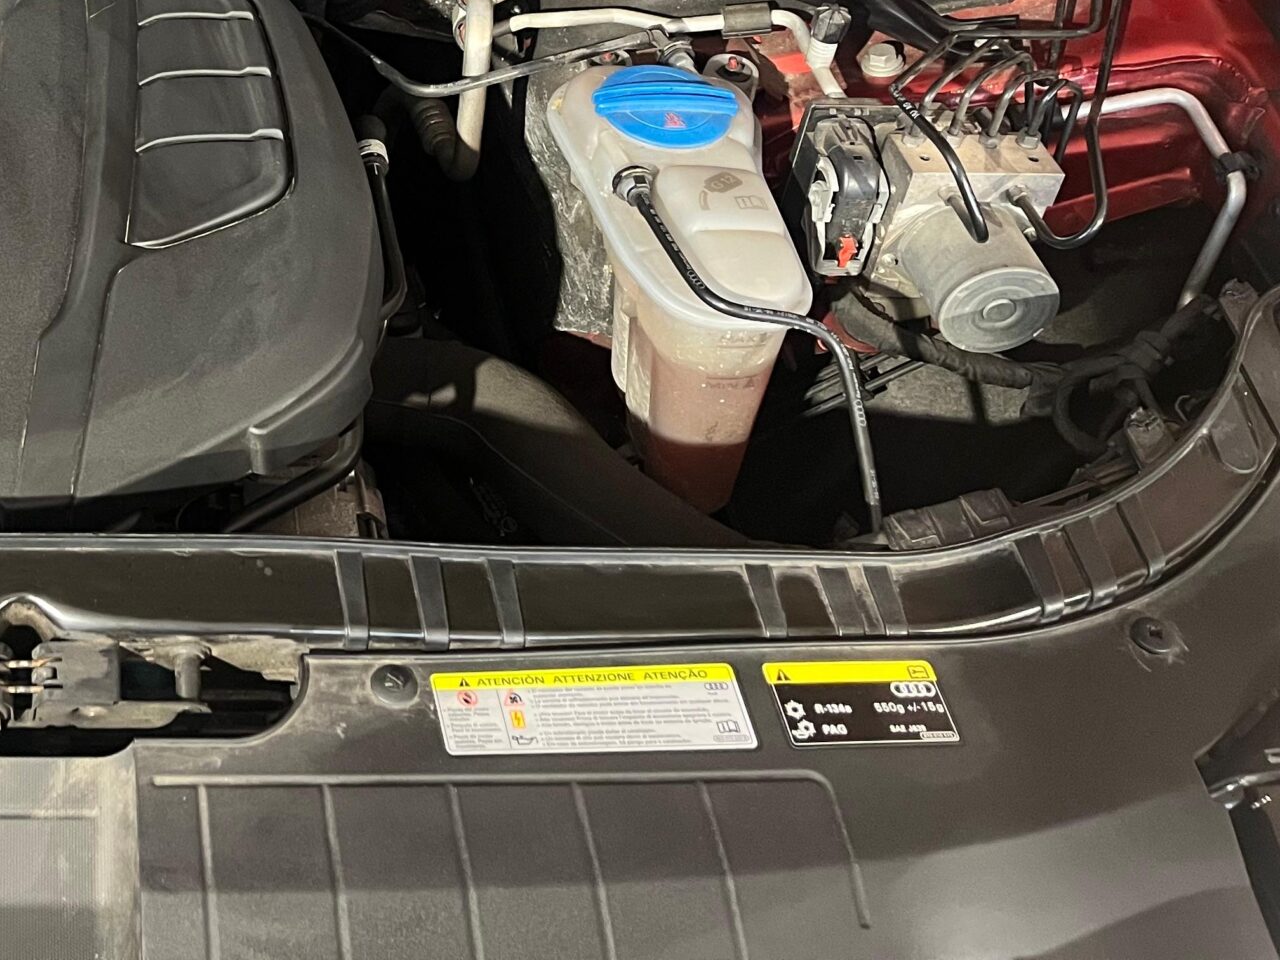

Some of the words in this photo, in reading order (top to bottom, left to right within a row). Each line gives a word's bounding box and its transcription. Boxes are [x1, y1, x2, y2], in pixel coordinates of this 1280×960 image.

[711, 174, 734, 189] G12
[477, 675, 545, 687] ATENCIÓN
[553, 672, 635, 684] ATTENZIONE
[643, 668, 708, 680] ATENÇÃO
[822, 724, 848, 735] PAG
